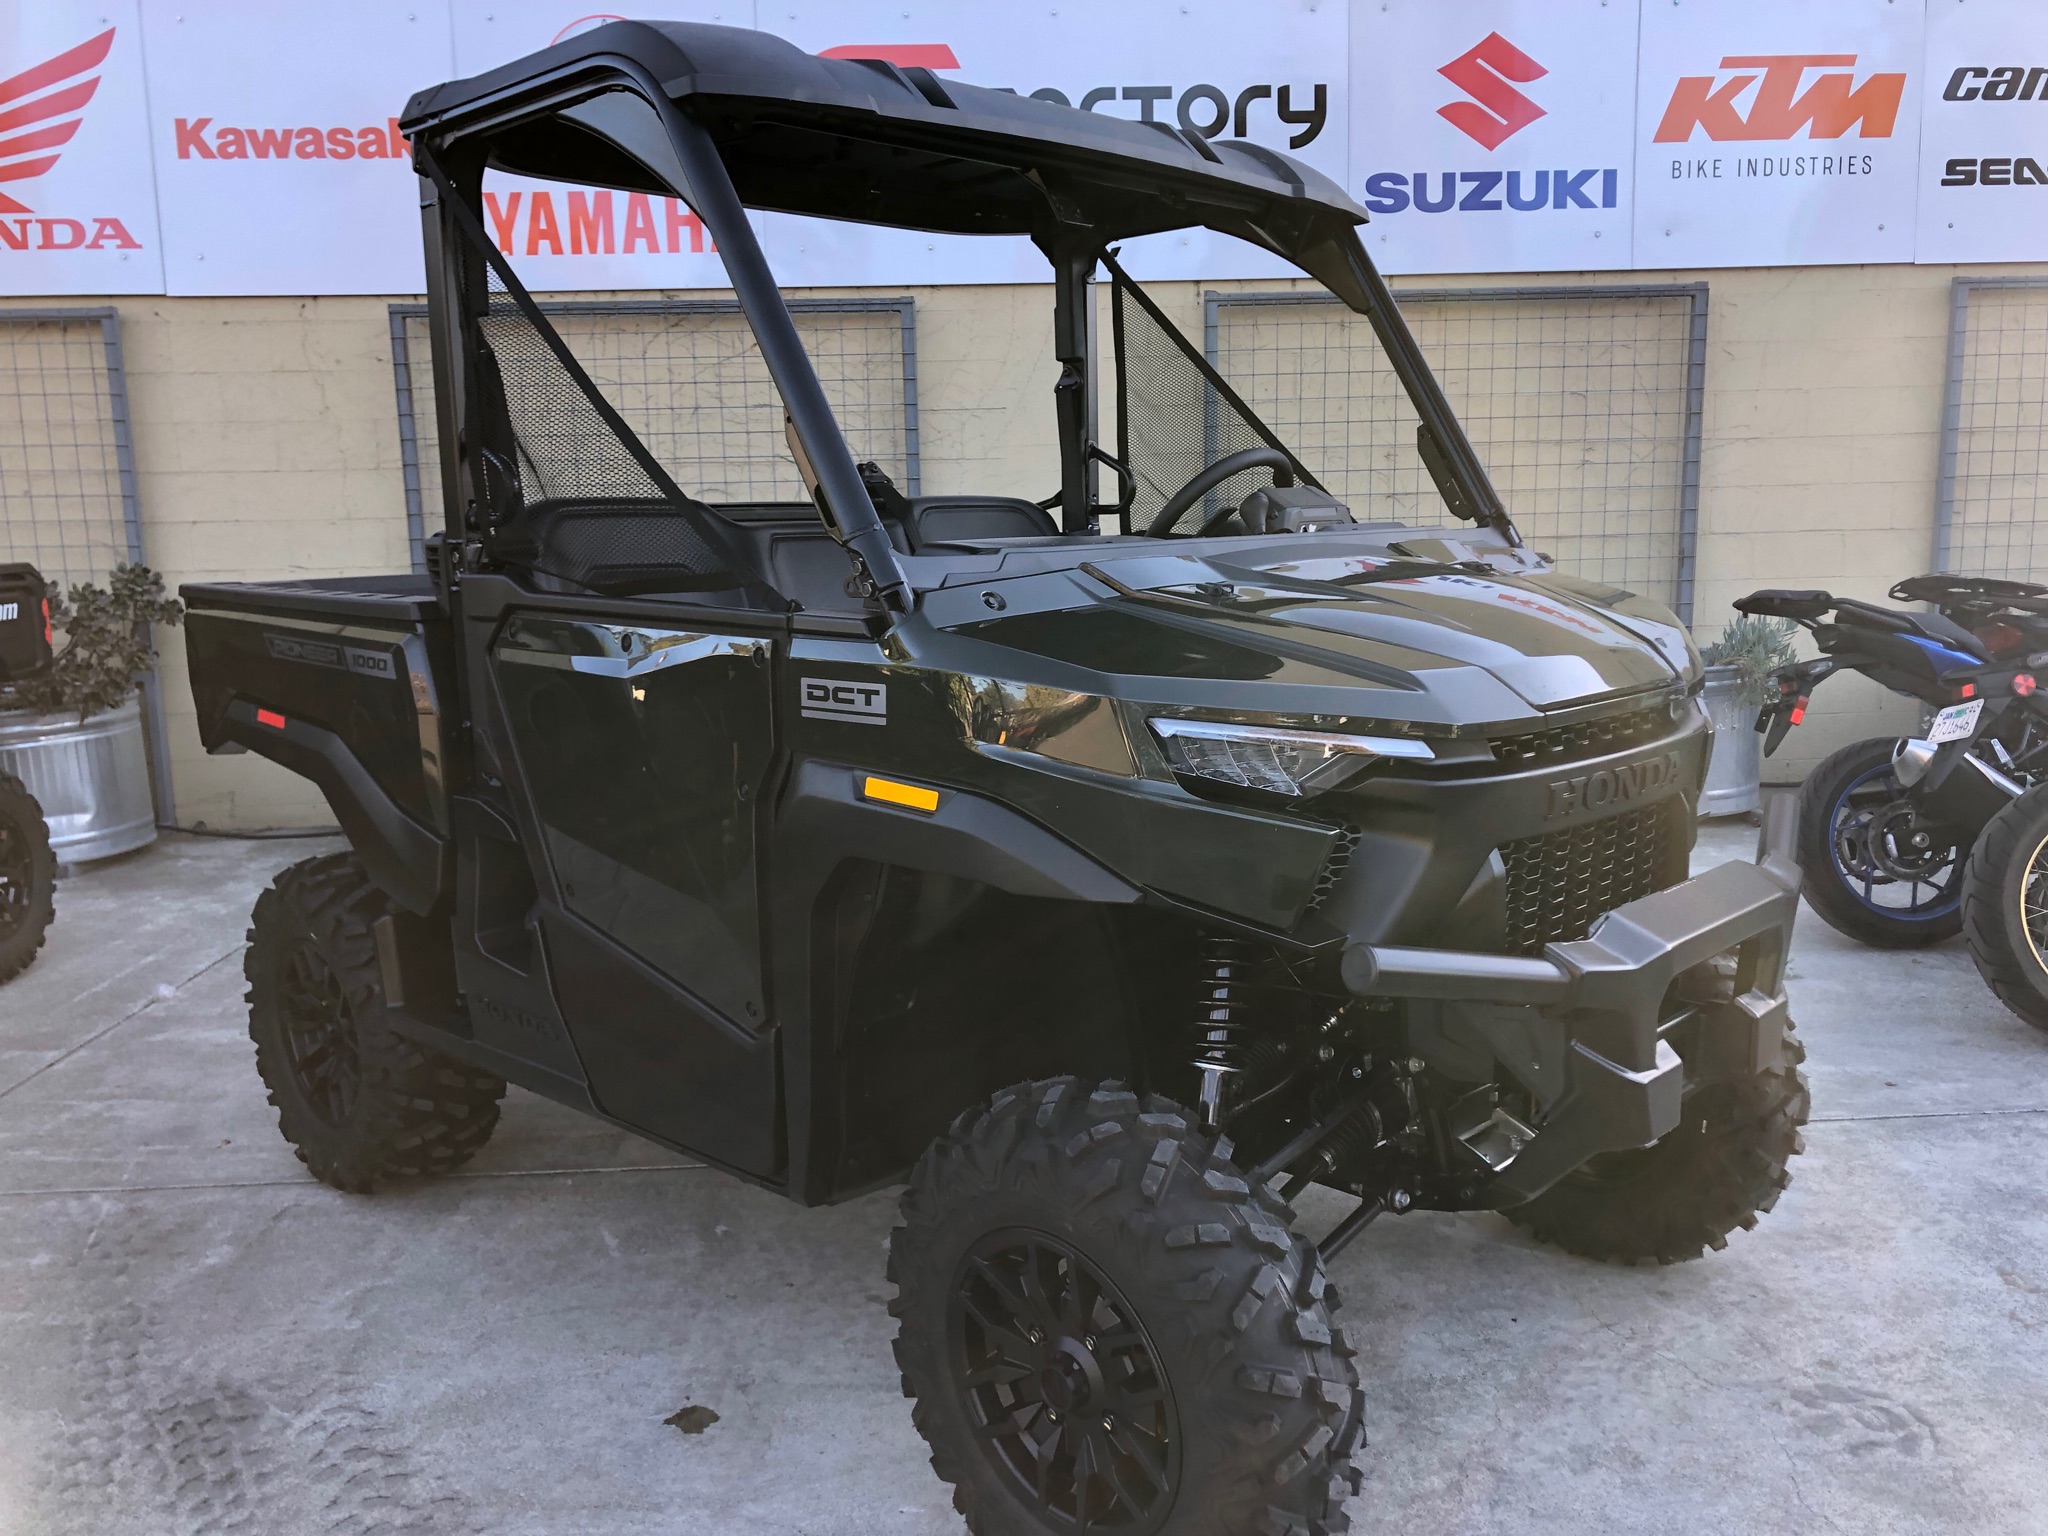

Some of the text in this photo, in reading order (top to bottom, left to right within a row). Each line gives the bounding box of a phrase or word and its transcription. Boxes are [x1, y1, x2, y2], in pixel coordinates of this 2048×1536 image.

[1652, 54, 1907, 143] KTM
[1671, 155, 1873, 179] BIKE INDUSTRIES
[1364, 168, 1618, 214] SUZUKI
[482, 190, 718, 257] YAMAH
[351, 653, 388, 672] 1000
[807, 683, 880, 707] DCT
[1545, 750, 1681, 821] HONDA
